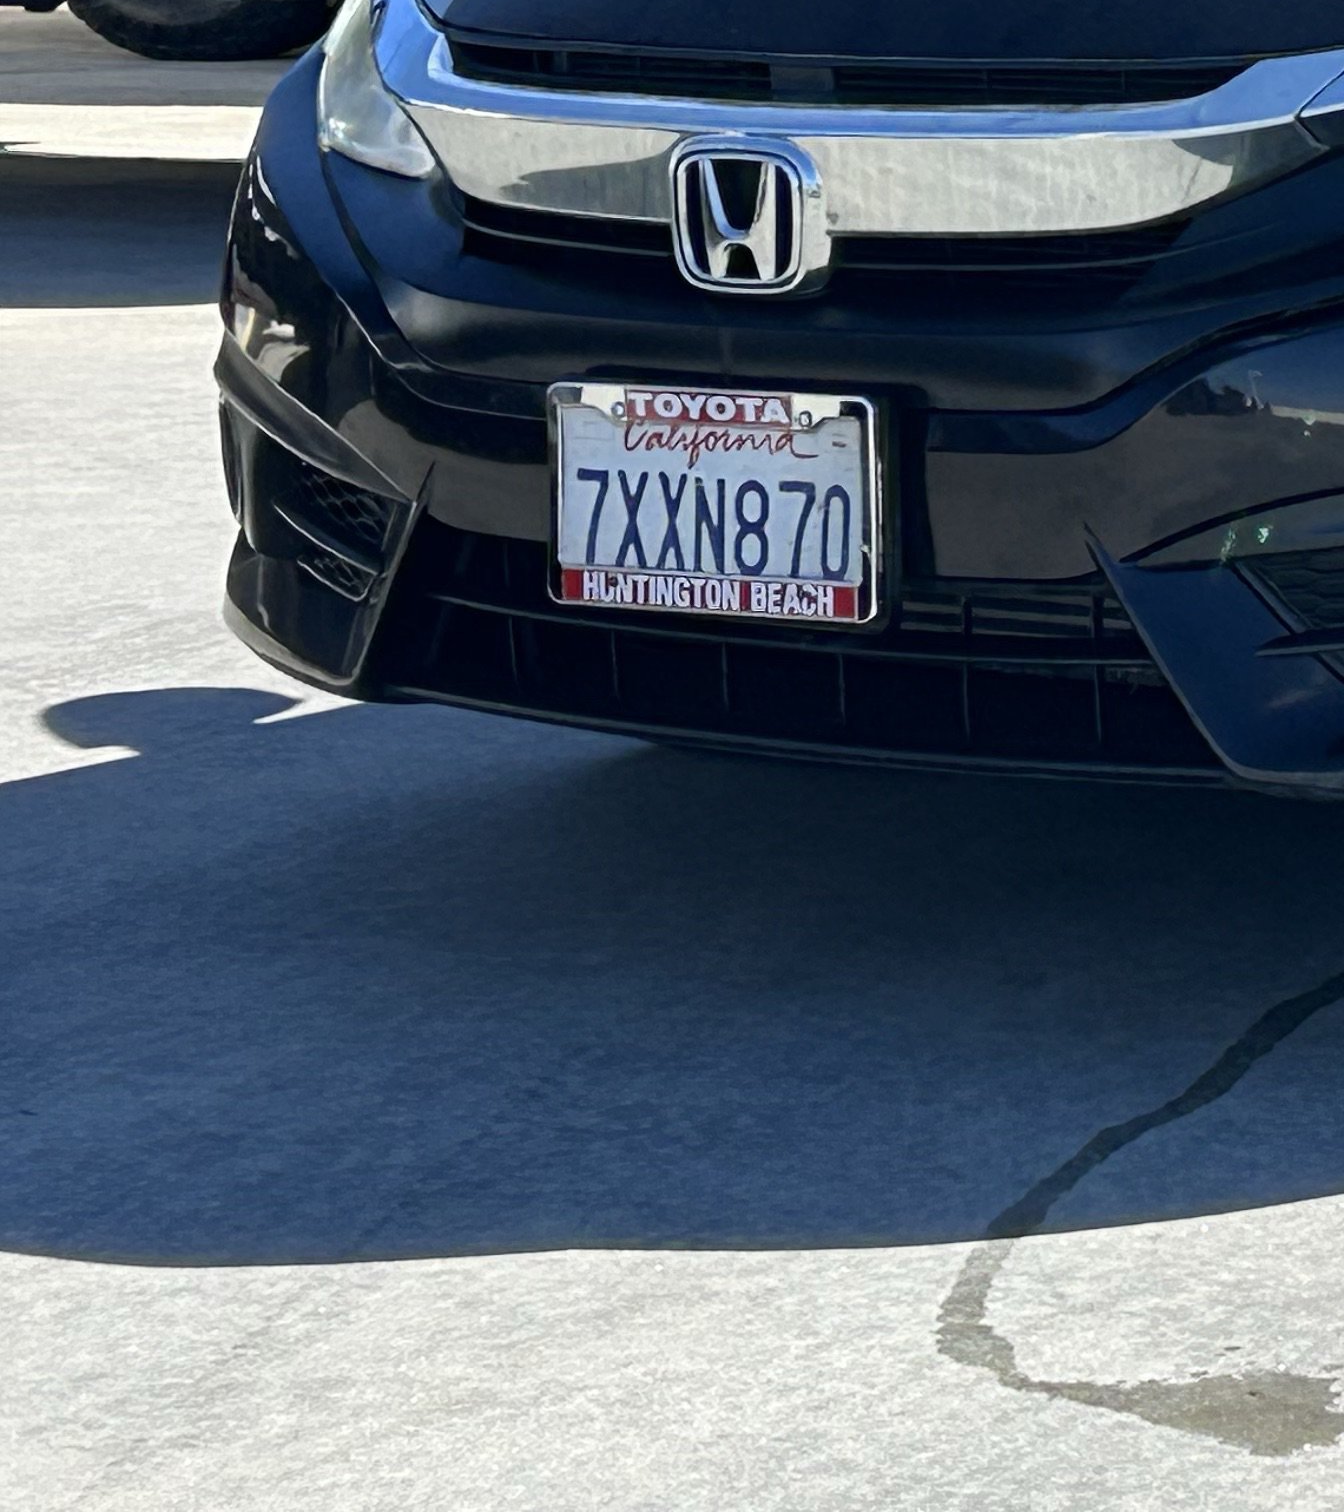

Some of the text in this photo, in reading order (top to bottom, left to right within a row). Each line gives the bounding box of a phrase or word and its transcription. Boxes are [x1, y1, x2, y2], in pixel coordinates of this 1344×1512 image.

[627, 391, 791, 424] TOYOTA
[624, 421, 819, 469] California
[577, 467, 852, 581] 7XXN870
[582, 571, 835, 618] HUNTINGTON BEACH
